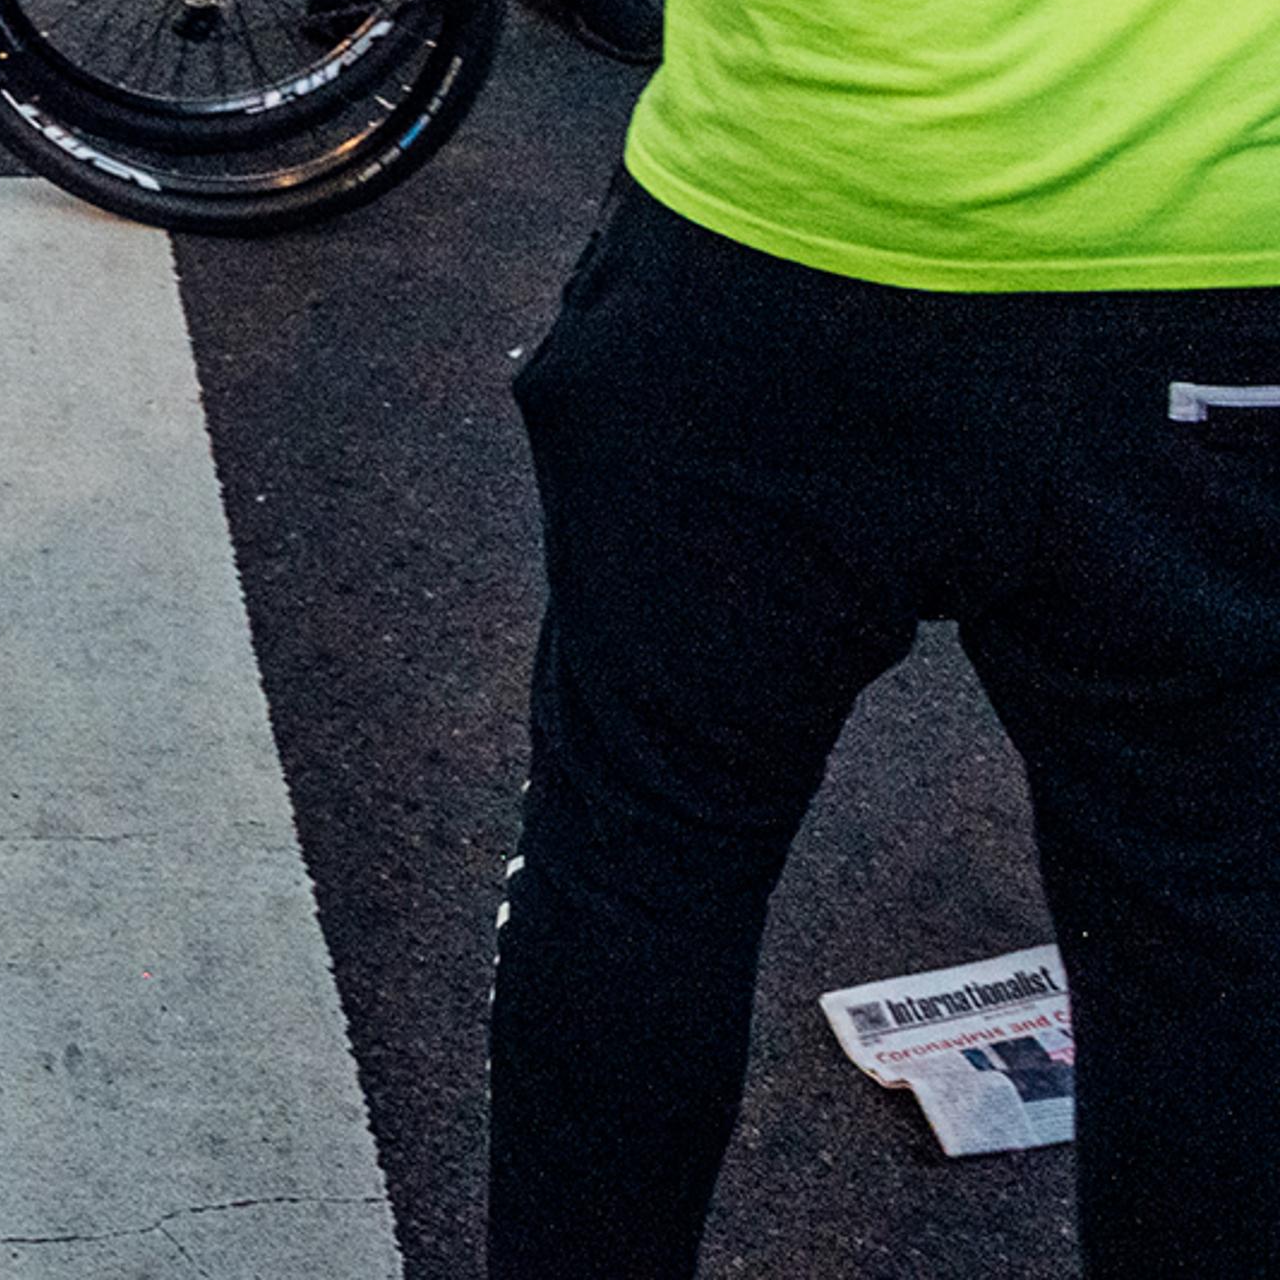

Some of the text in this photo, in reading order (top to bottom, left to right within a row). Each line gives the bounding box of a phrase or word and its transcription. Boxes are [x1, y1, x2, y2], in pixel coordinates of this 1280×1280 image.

[885, 965, 1060, 1026] Internationalist
[875, 1026, 1007, 1065] Coronavirus
[1008, 1014, 1052, 1036] and
